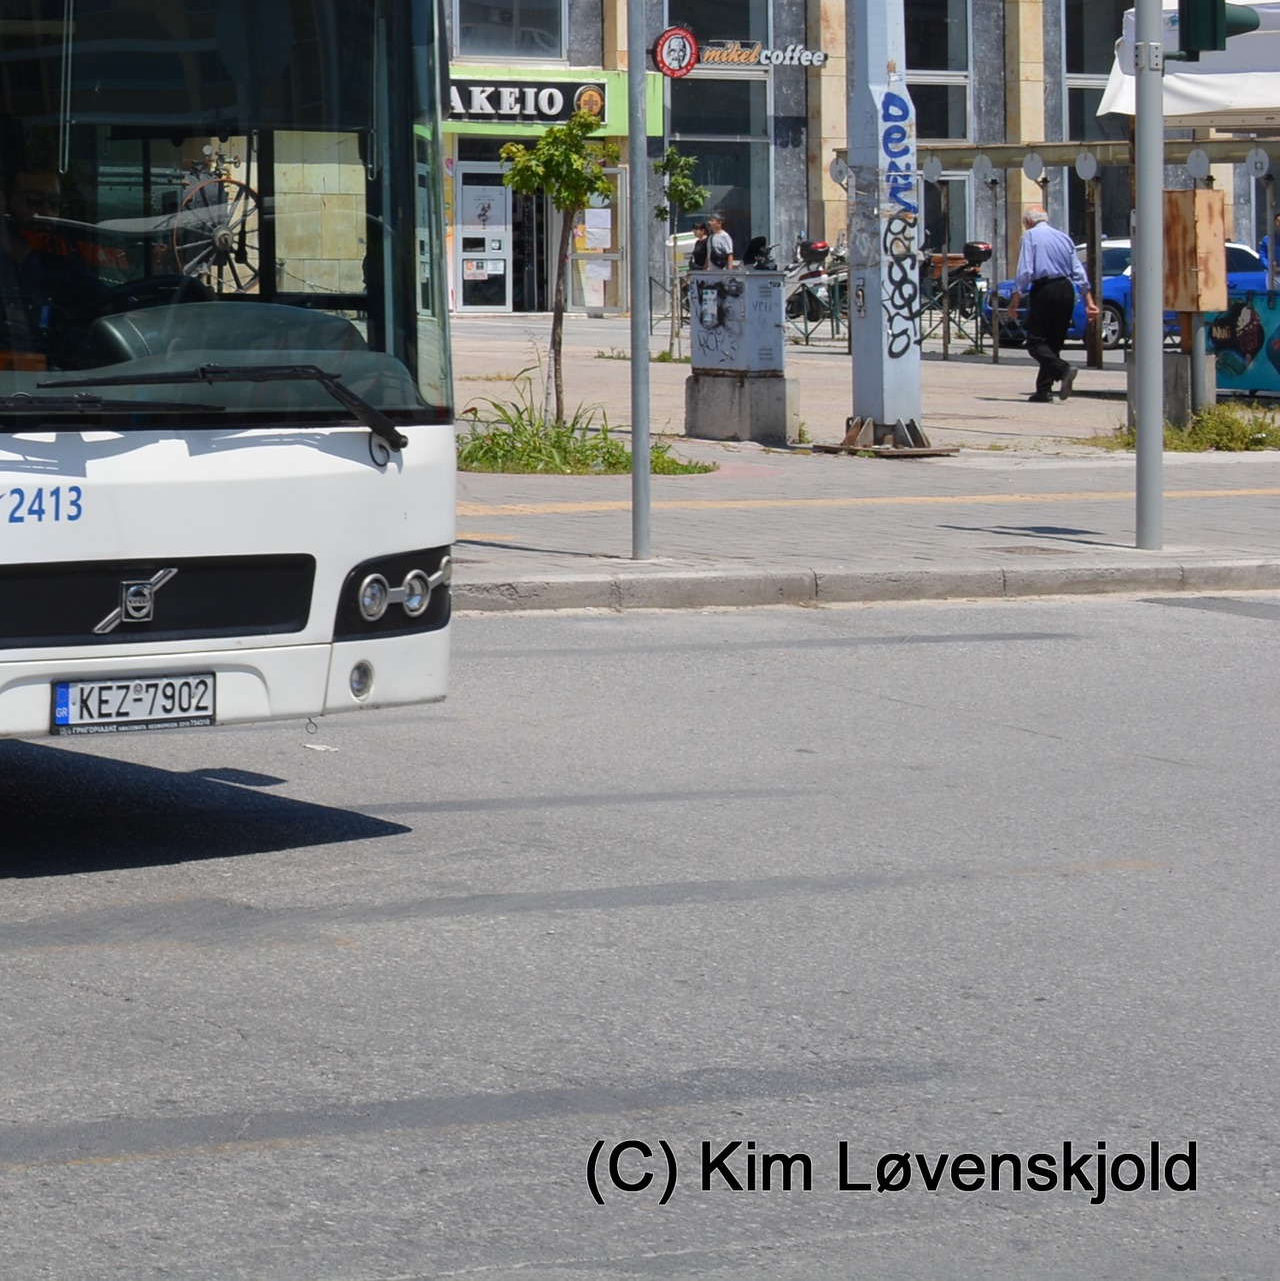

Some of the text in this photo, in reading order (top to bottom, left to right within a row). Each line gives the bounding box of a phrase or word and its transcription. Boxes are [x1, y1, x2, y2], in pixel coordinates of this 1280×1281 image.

[702, 41, 761, 64] mikel
[760, 44, 825, 66] coffee
[8, 485, 82, 523] 2413
[56, 707, 68, 718] GR
[79, 679, 209, 720] KEZ-7902
